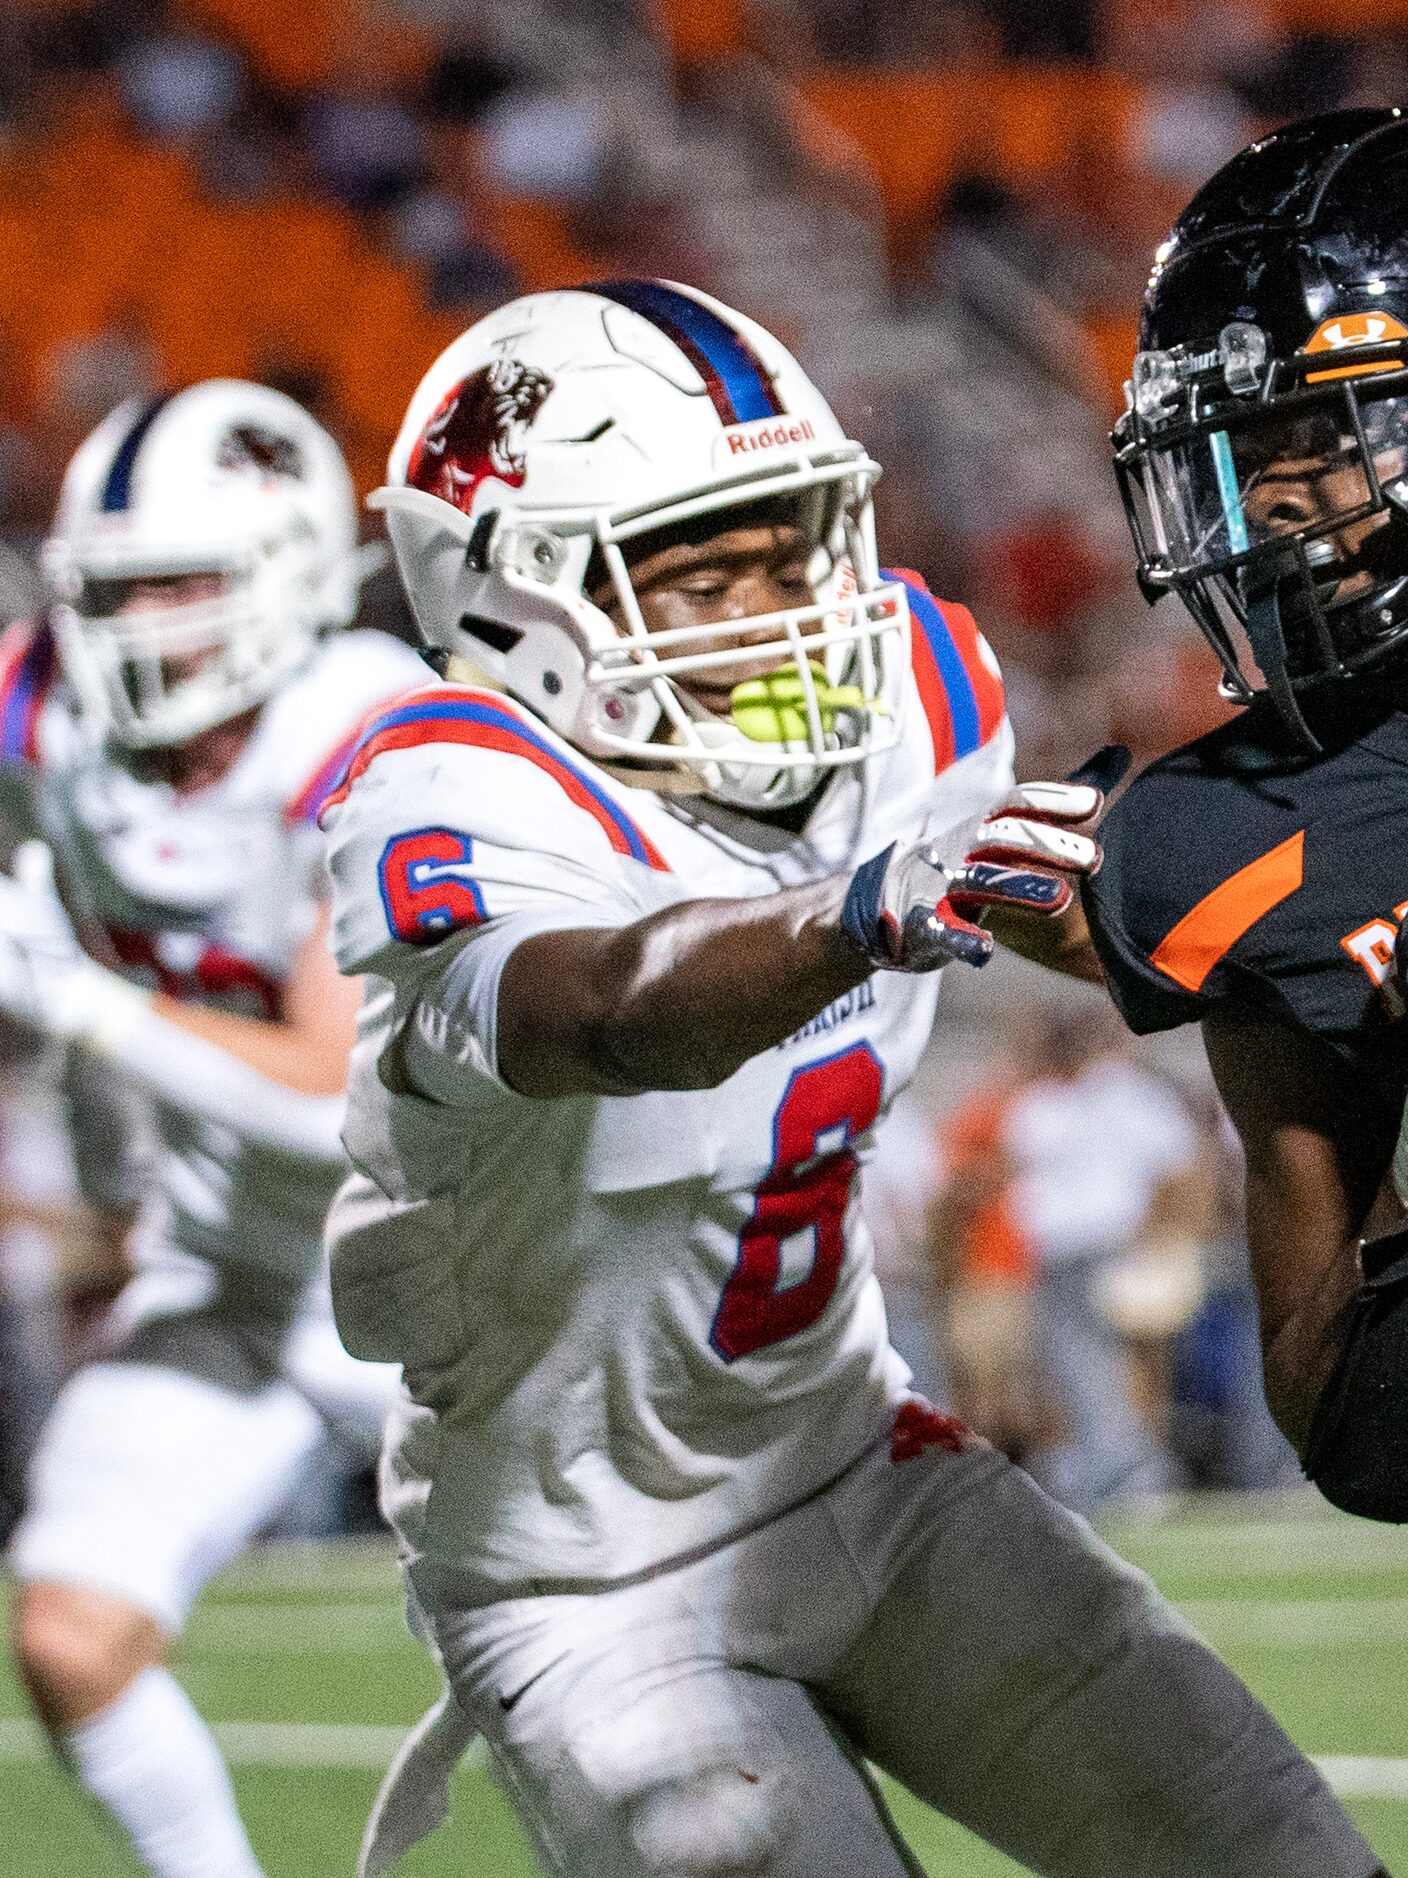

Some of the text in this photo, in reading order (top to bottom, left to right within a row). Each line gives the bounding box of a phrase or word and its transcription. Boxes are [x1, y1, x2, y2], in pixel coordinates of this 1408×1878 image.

[726, 418, 817, 455] Riddell
[377, 825, 490, 945] 6
[708, 1037, 887, 1364] 6
